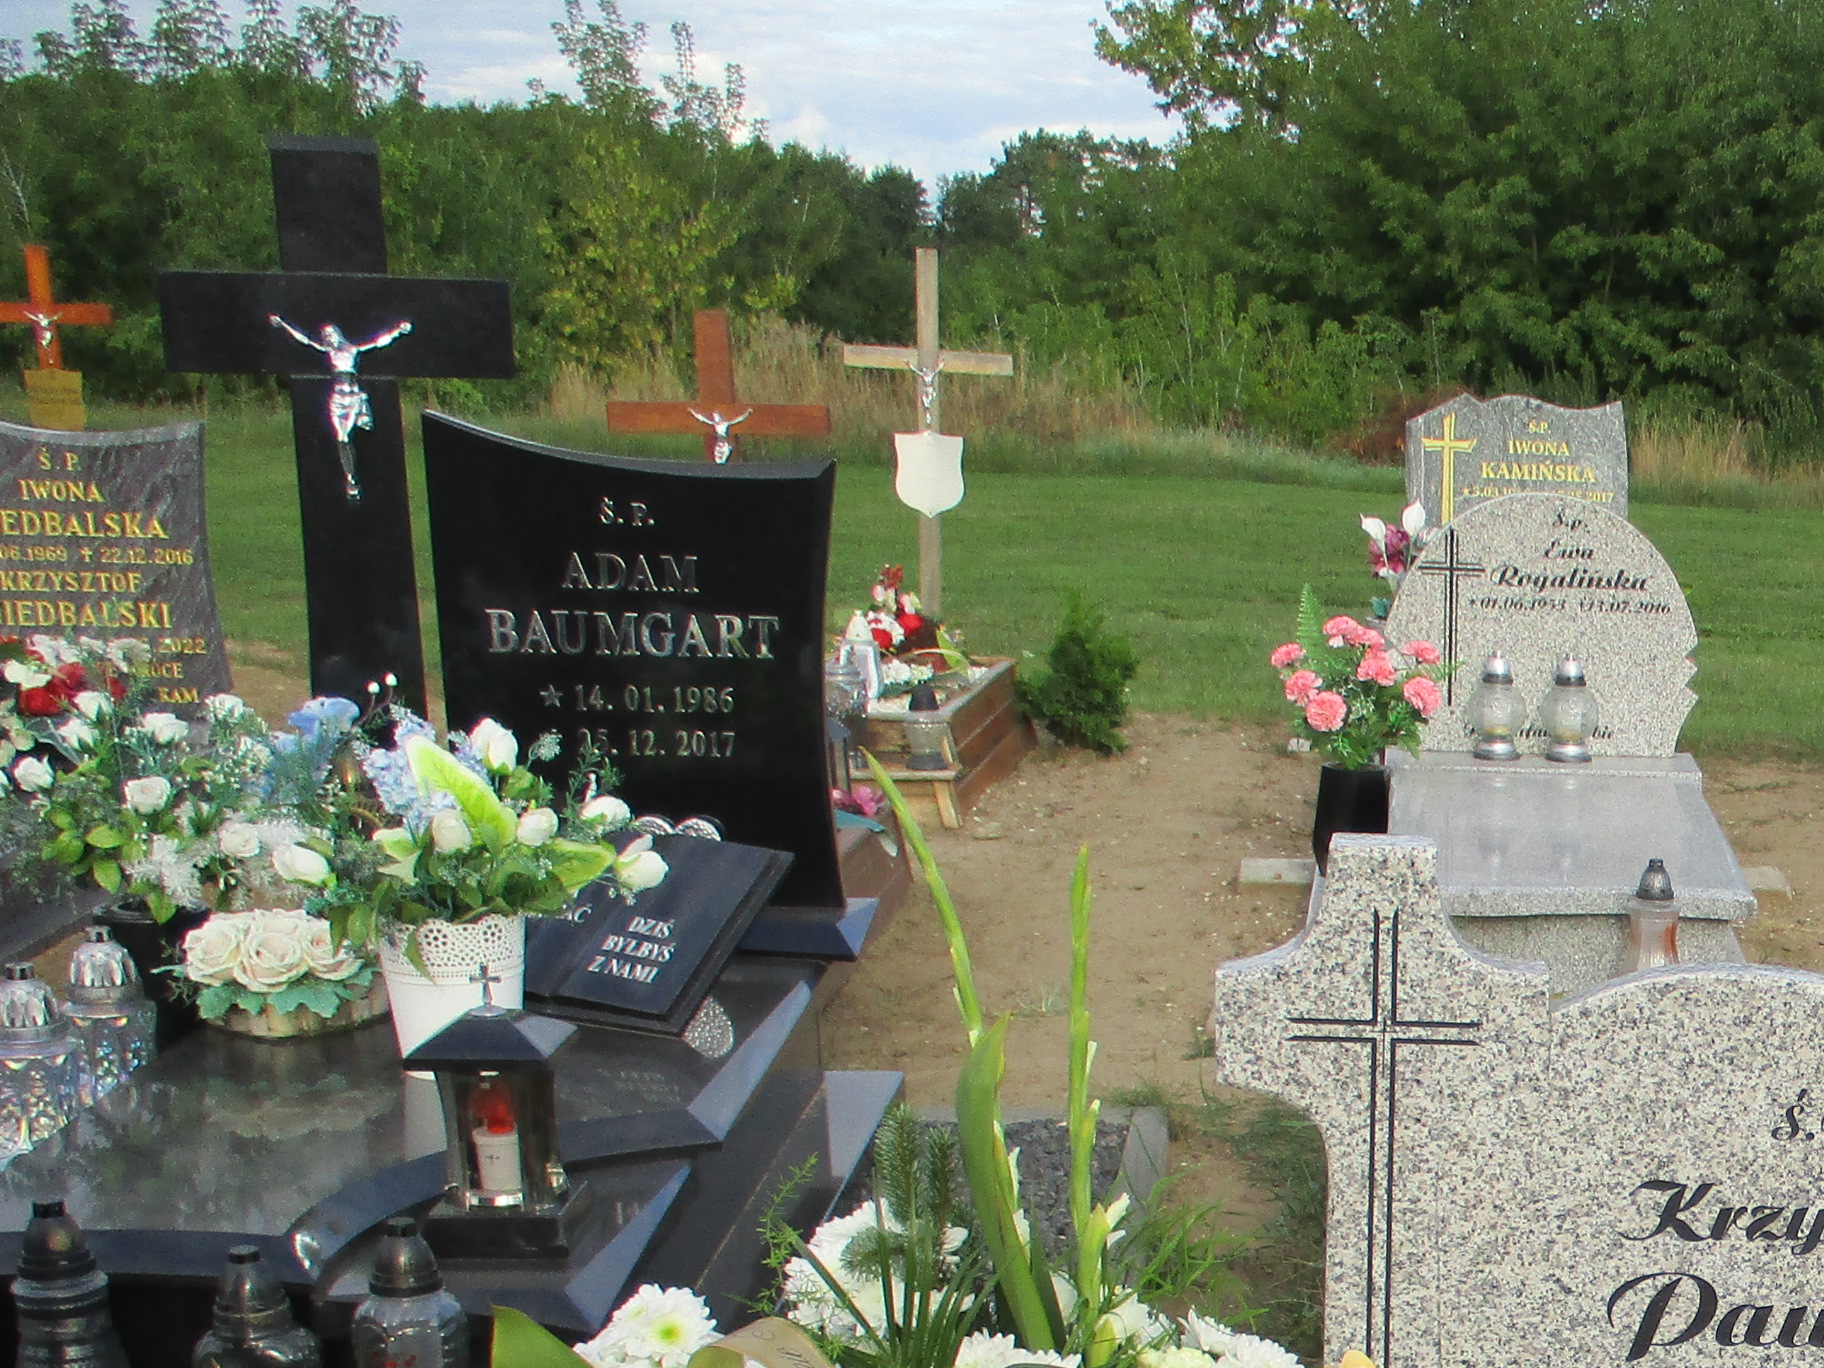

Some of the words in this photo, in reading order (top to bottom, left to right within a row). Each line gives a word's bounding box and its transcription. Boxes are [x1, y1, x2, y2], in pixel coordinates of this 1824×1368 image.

[1508, 438, 1570, 456] IWONA
[1481, 460, 1597, 483] KAMIŃSKA
[18, 480, 105, 502] IWONA
[100, 547, 193, 565] 22.12.2016
[1544, 538, 1594, 560] Ewa
[0, 570, 141, 593] KRZYSZTOF
[561, 551, 699, 593] ADAM
[1490, 565, 1649, 592] Rogalińska
[484, 608, 779, 659] BAUMGART
[627, 915, 675, 939] DZIŚ
[587, 955, 606, 972] Z
[604, 957, 660, 983] NAMI
